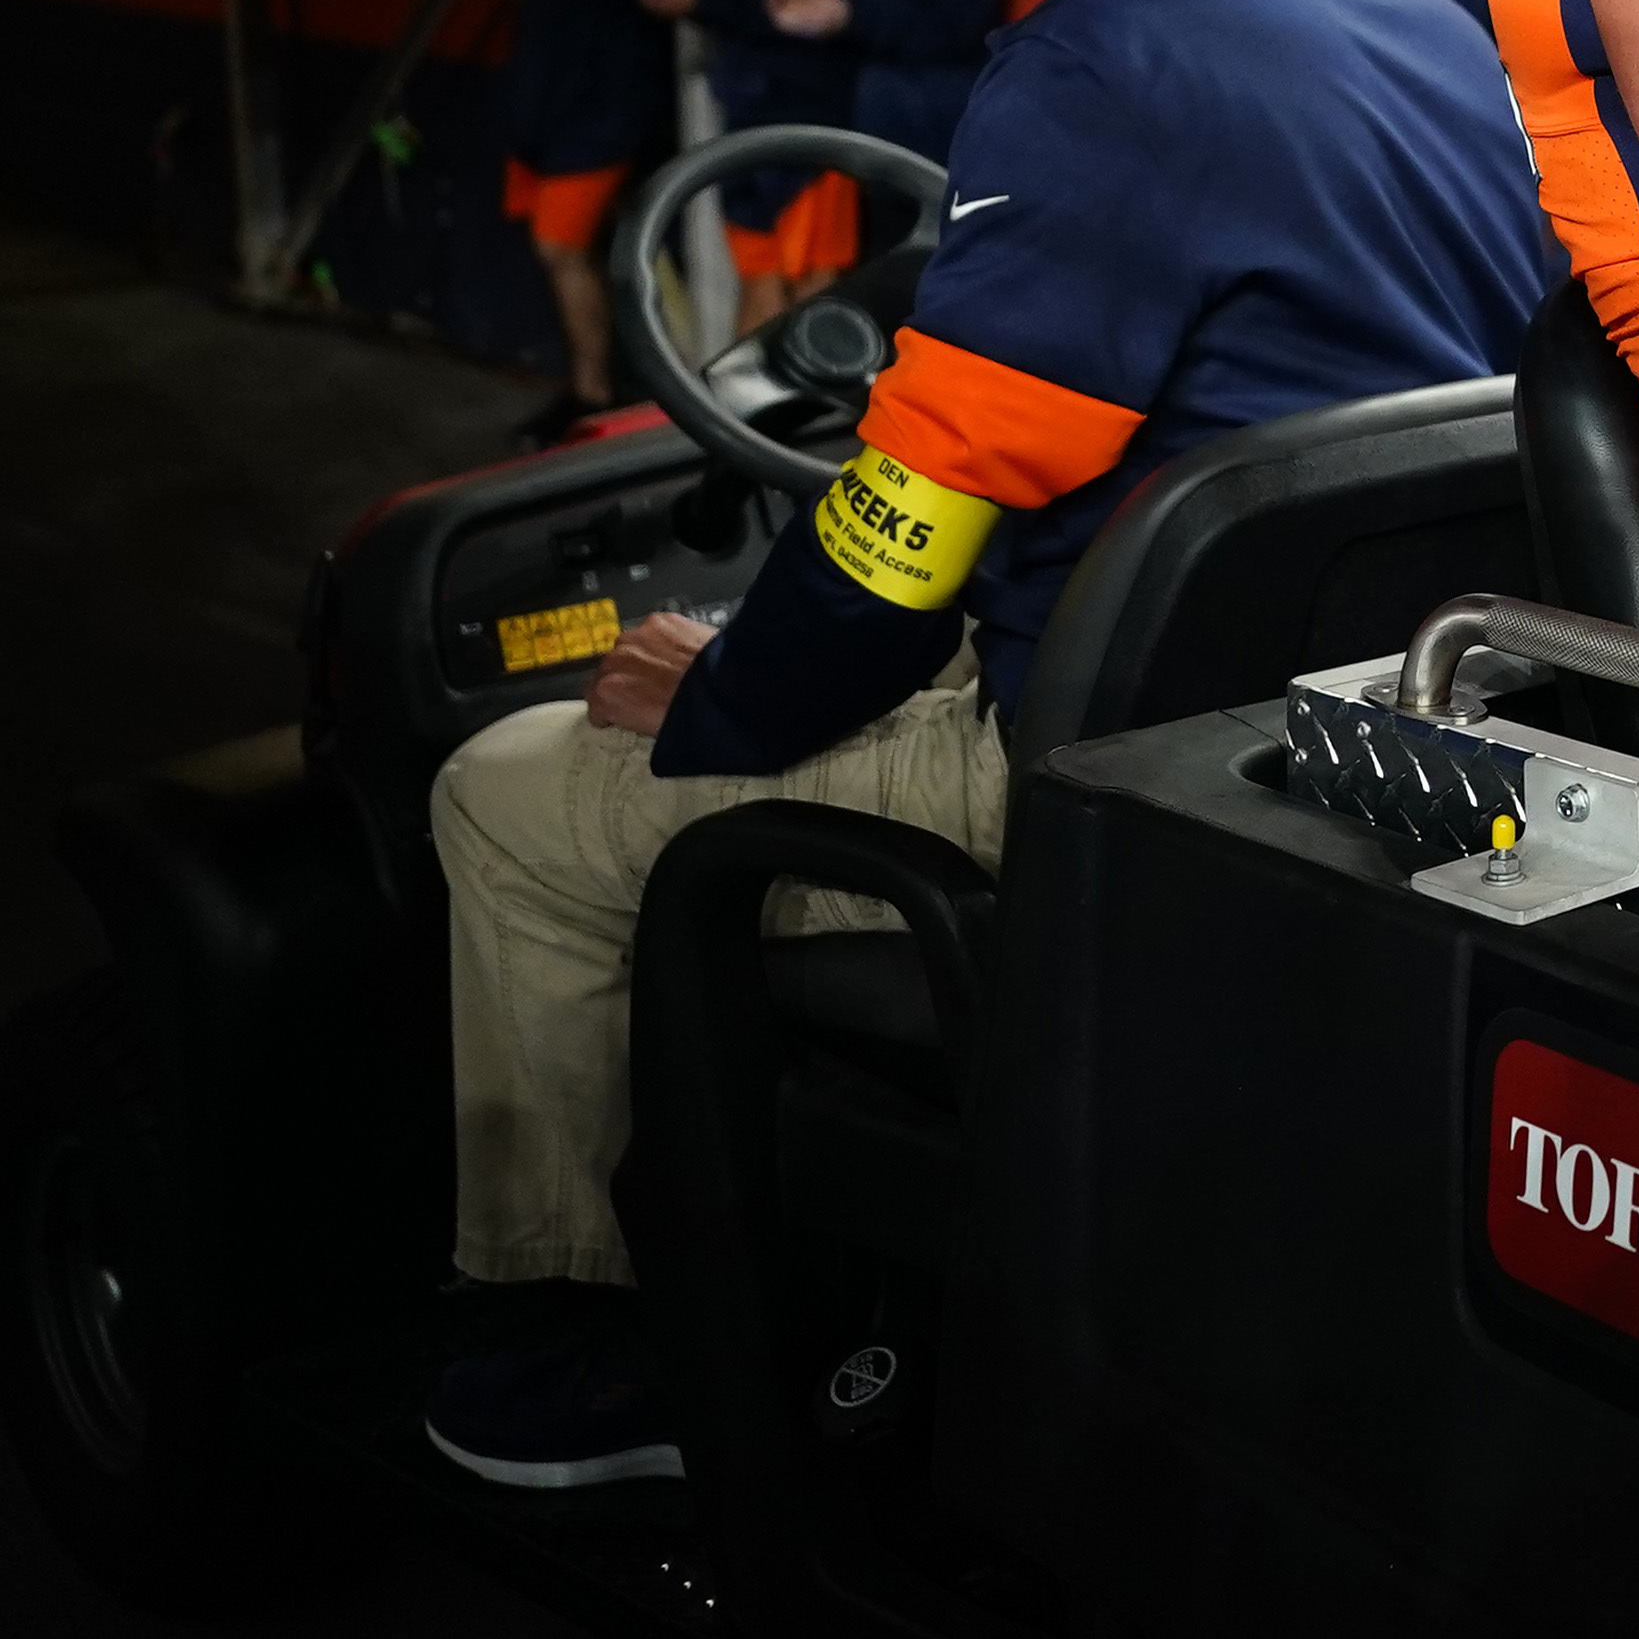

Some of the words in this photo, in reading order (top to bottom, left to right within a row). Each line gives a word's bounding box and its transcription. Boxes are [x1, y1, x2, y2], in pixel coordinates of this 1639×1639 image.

[878, 457, 910, 490] DEN
[841, 521, 874, 556] Field
[874, 548, 935, 583] Access
[904, 520, 935, 553] 5
